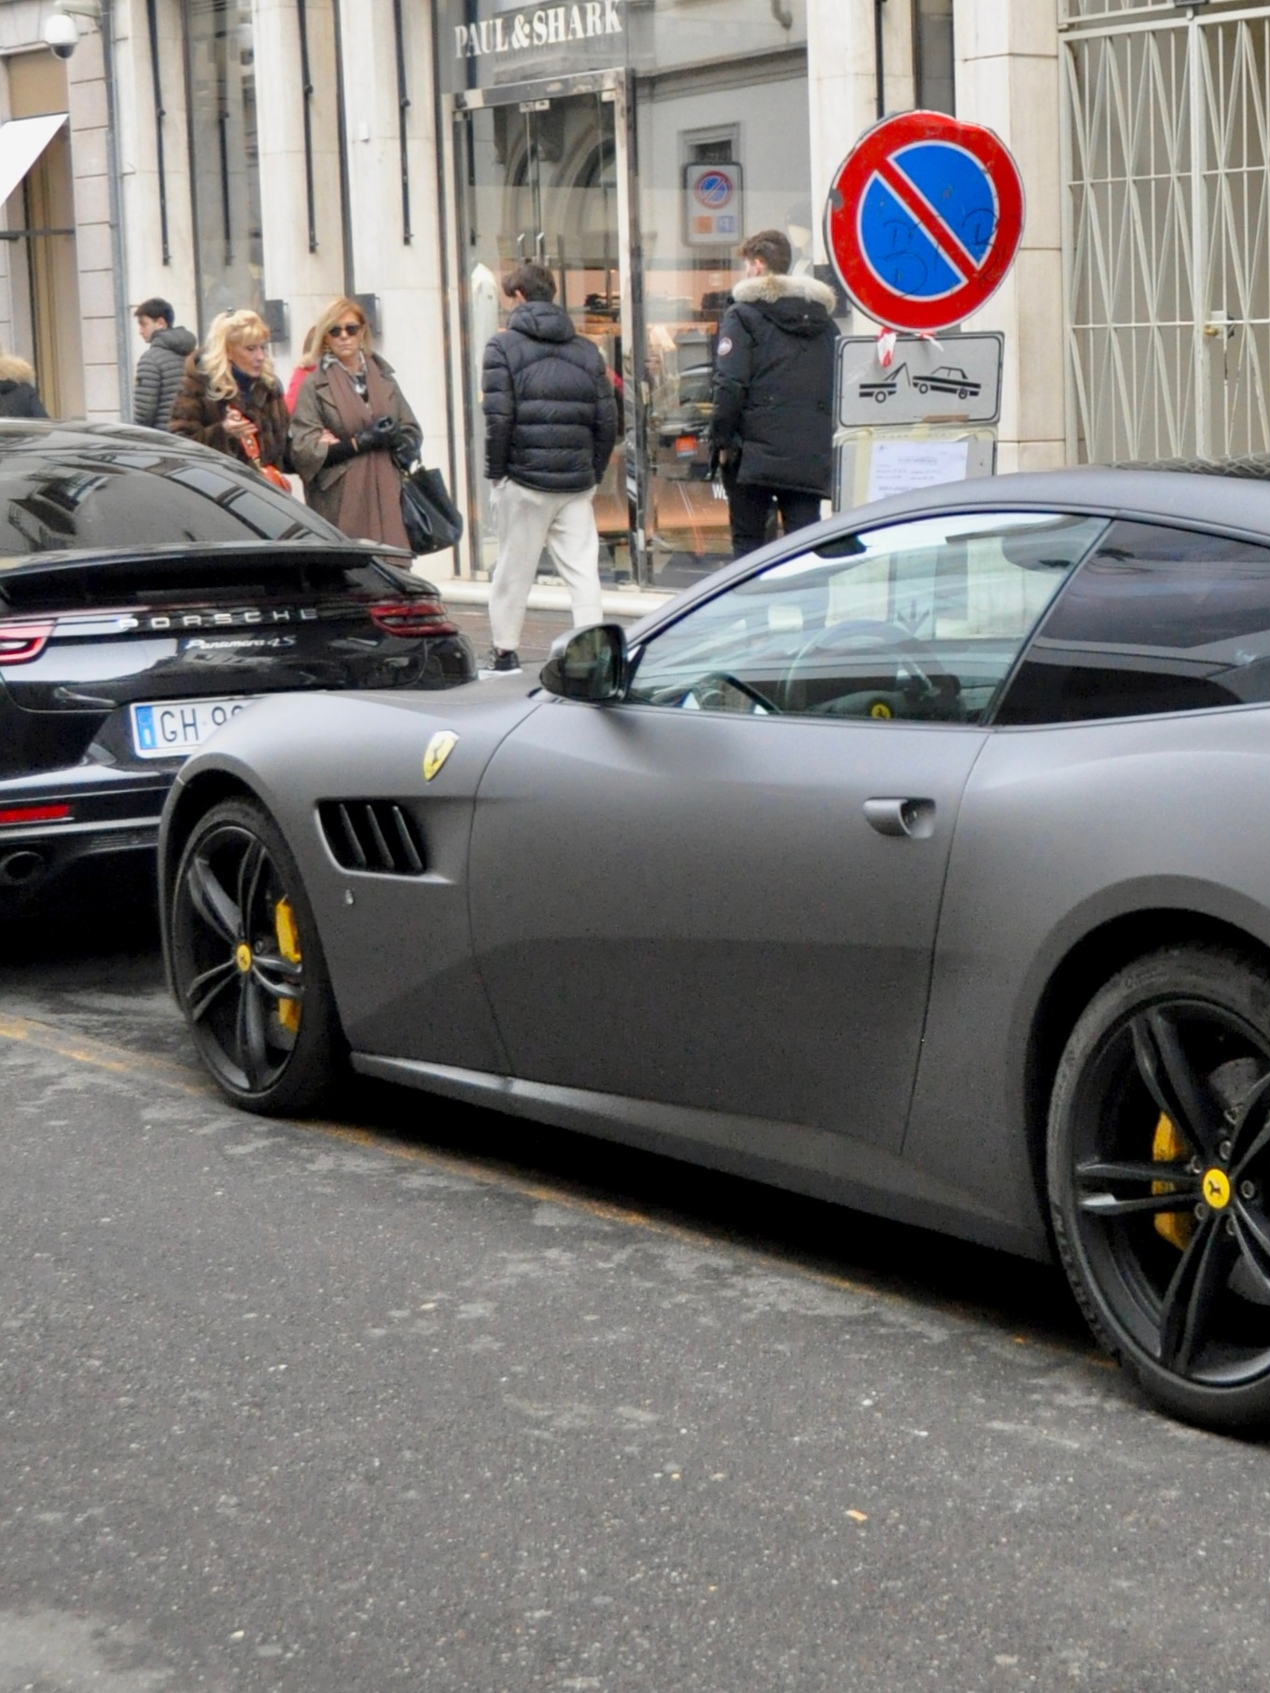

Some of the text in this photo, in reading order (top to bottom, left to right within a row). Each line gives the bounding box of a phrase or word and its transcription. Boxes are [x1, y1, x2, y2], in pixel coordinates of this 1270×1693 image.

[118, 609, 318, 629] PORSCHE
[185, 638, 265, 650] Panamera
[160, 703, 199, 743] GH
